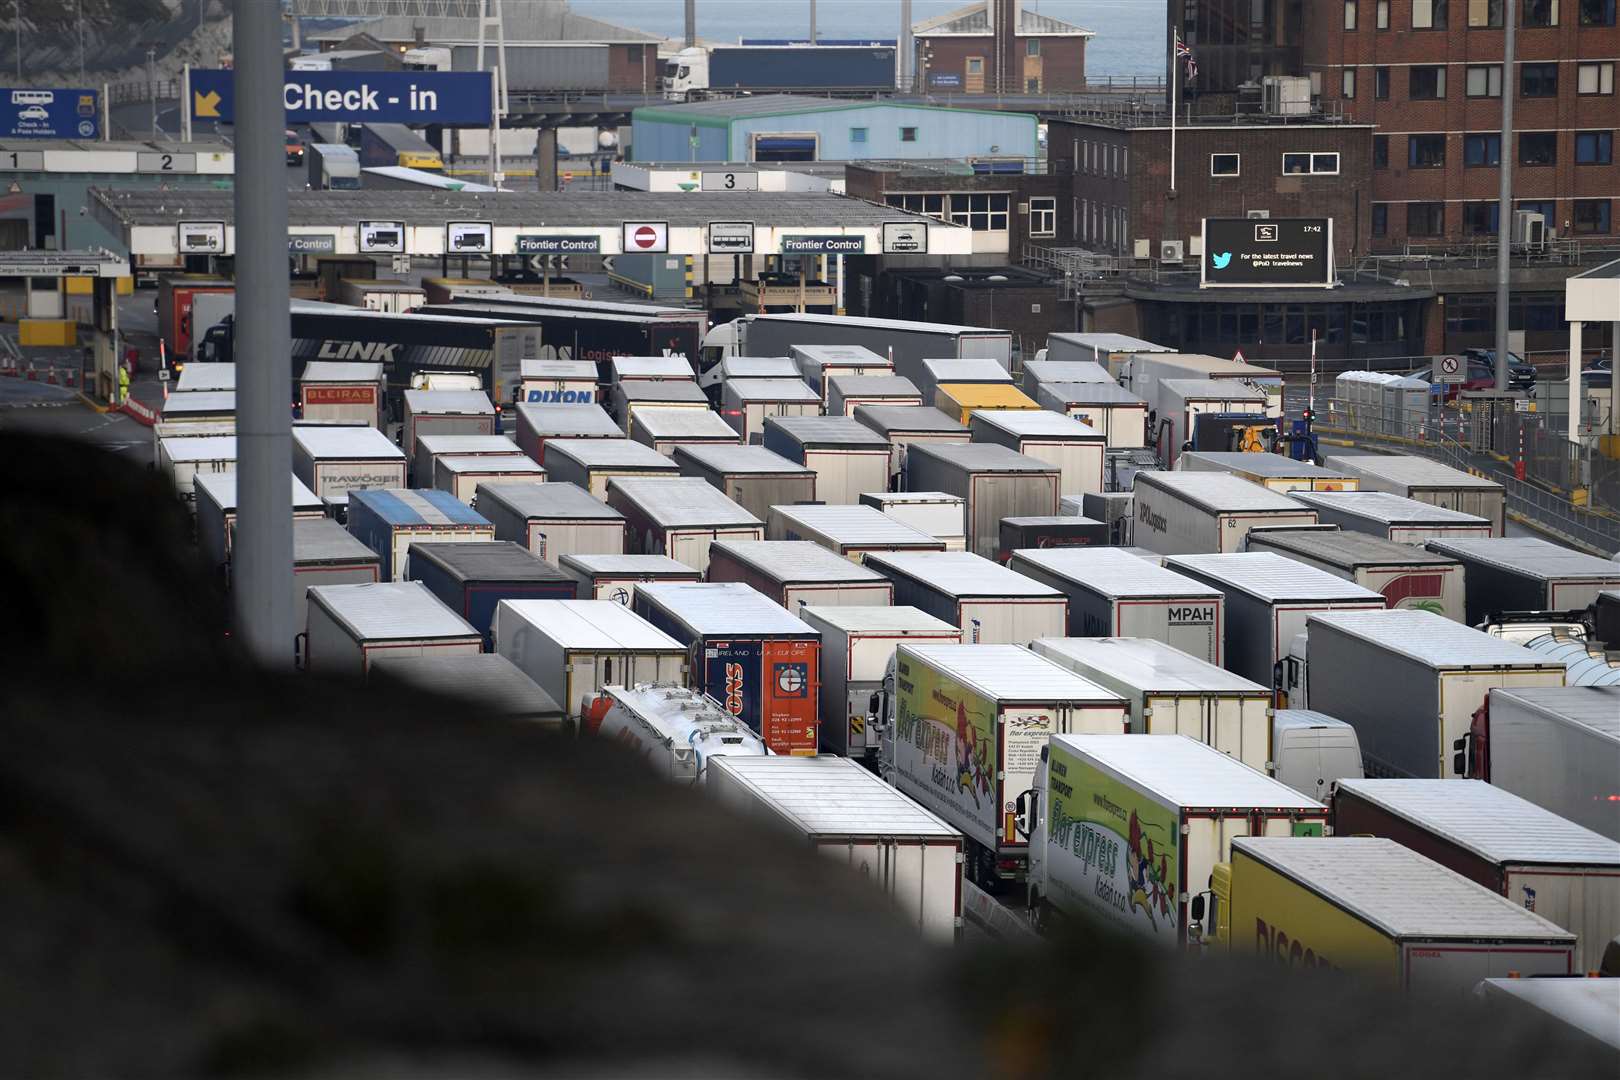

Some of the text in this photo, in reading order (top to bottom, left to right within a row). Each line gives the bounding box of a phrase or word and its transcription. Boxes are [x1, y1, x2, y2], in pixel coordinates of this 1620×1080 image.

[283, 84, 379, 110] Check
[410, 84, 437, 110] in
[10, 153, 17, 168] 1
[161, 154, 173, 170] 2
[725, 173, 735, 189] 3
[295, 239, 332, 249] Control
[520, 240, 597, 249] Frontier Control
[786, 240, 861, 249] Frontier Control
[307, 389, 371, 400] BLEIRAS
[528, 390, 592, 403] DIXON
[1228, 519, 1237, 528] 62
[1168, 607, 1214, 620] MPAH
